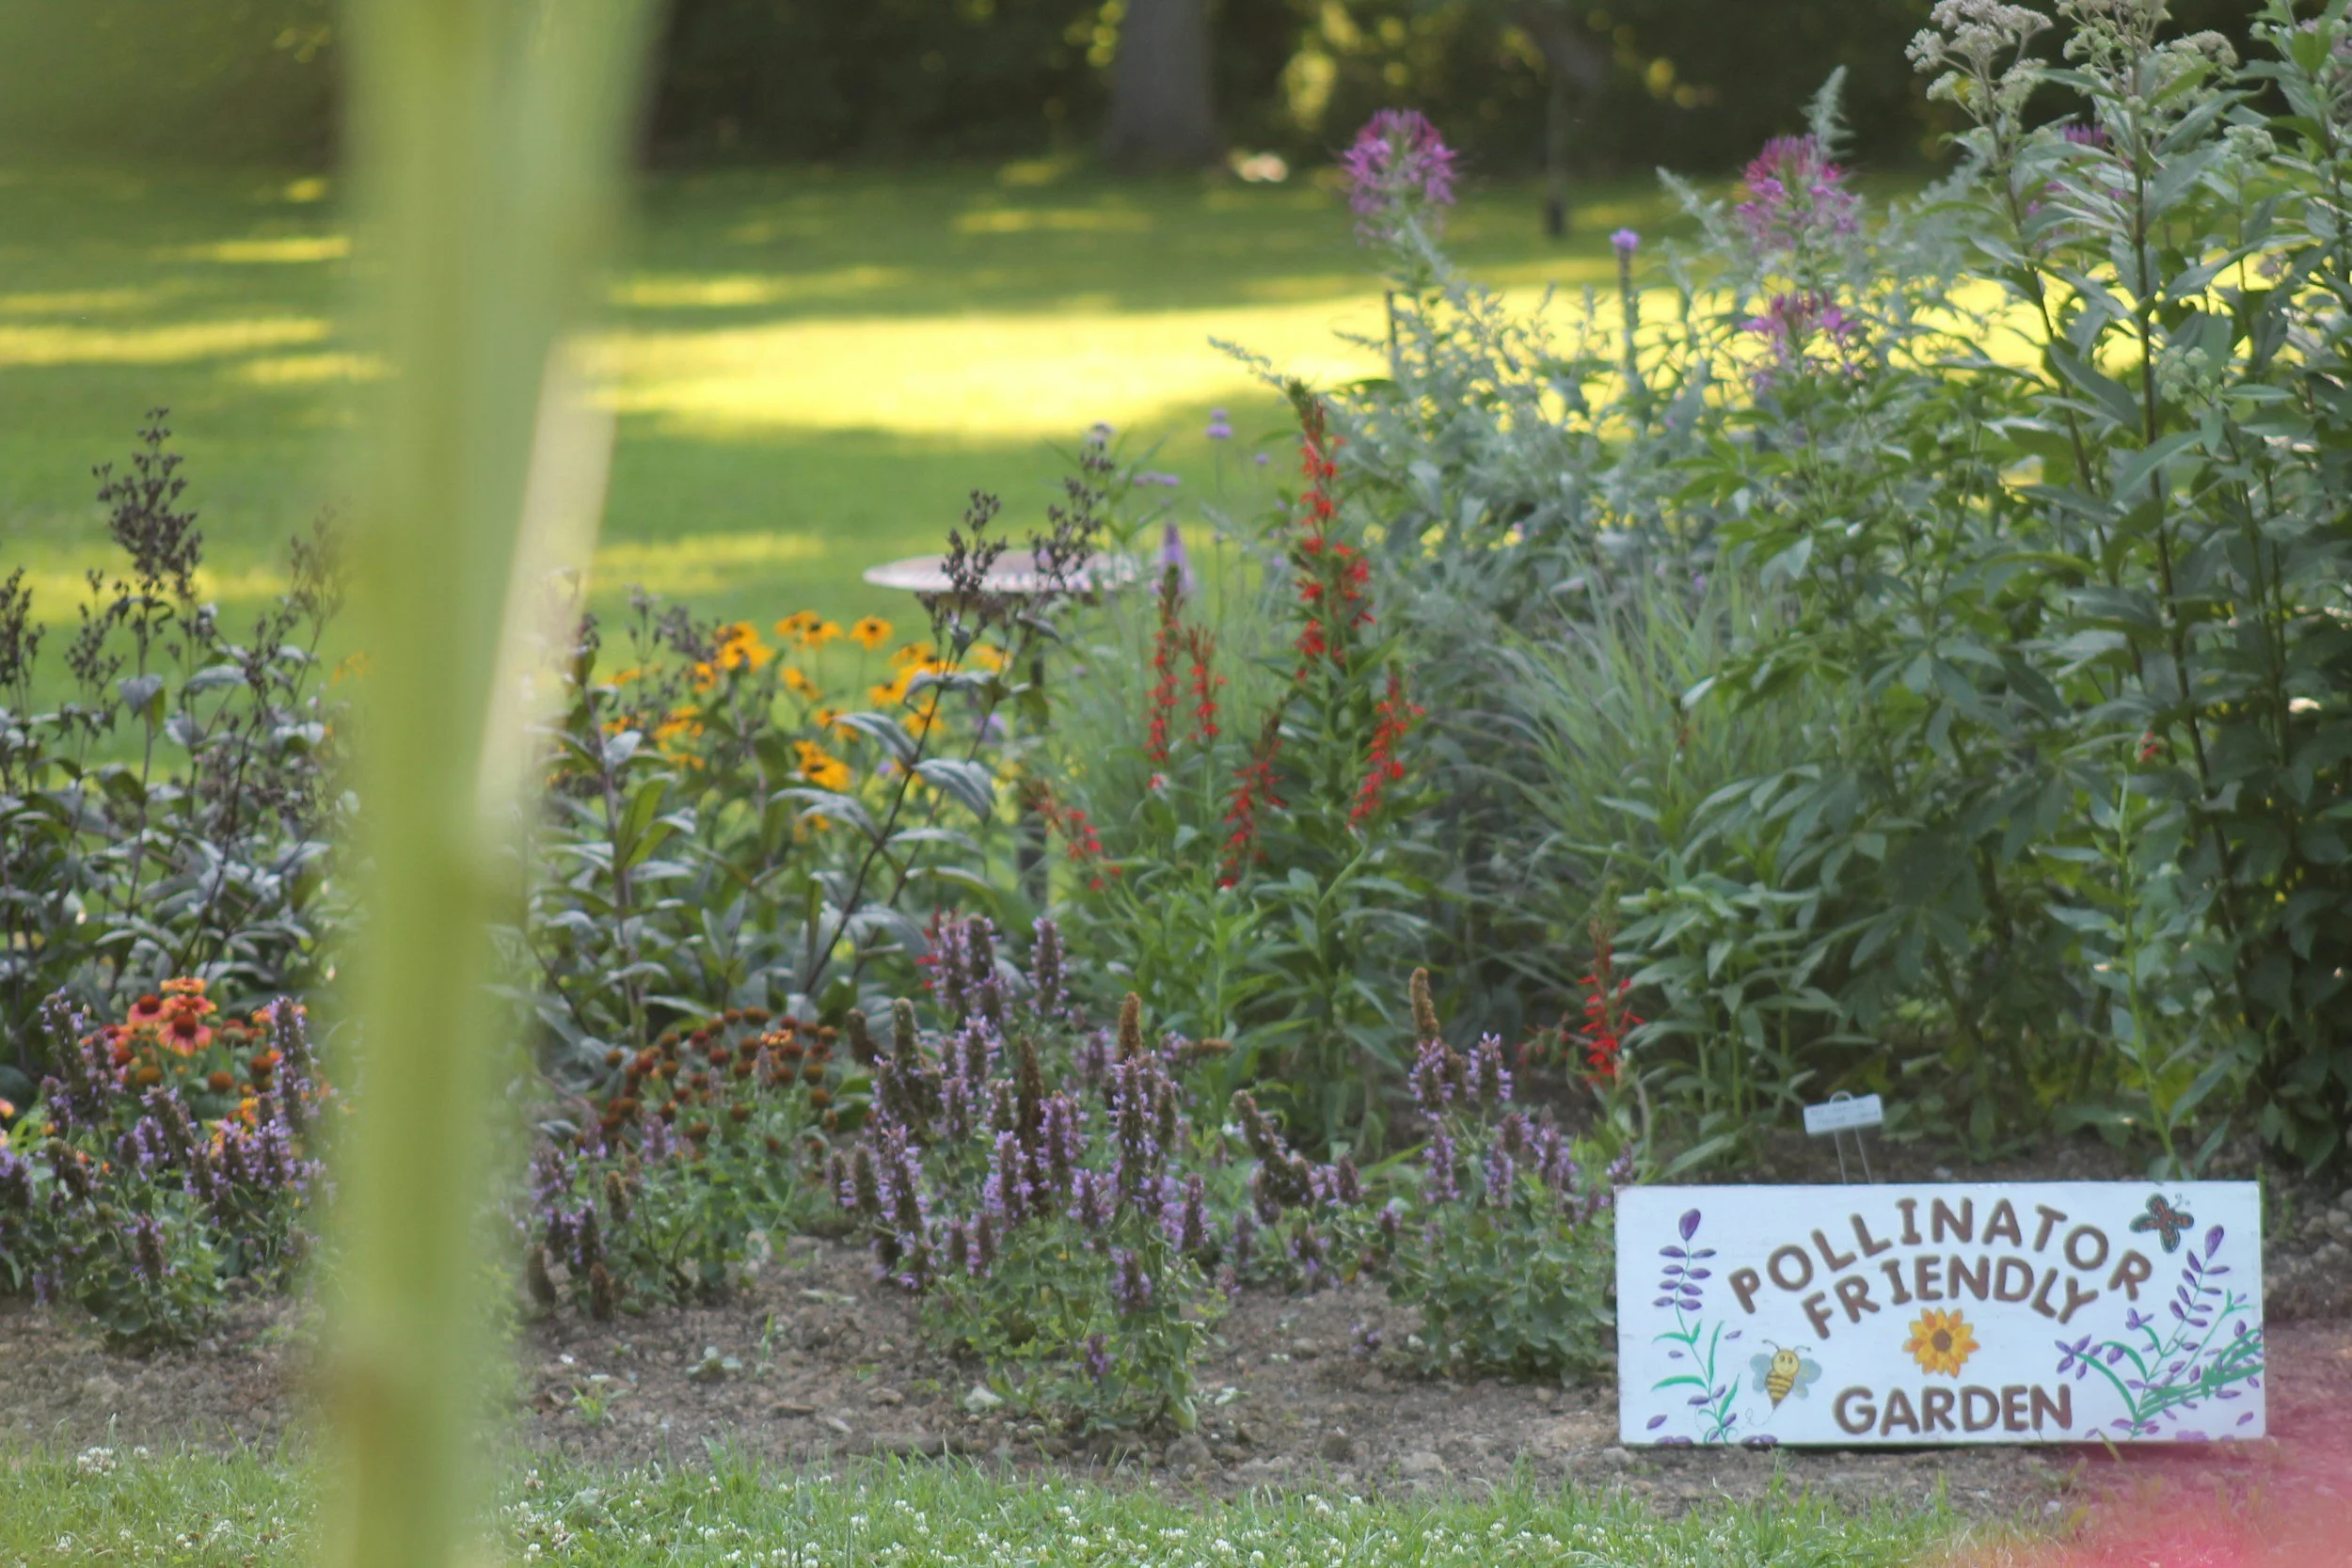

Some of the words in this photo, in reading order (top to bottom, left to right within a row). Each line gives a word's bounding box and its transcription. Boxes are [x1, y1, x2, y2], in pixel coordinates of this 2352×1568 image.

[1728, 1197, 2153, 1314] POLLINATOR
[1802, 1255, 2099, 1339] FRIENDLY
[1833, 1385, 2074, 1436] GARDEN
